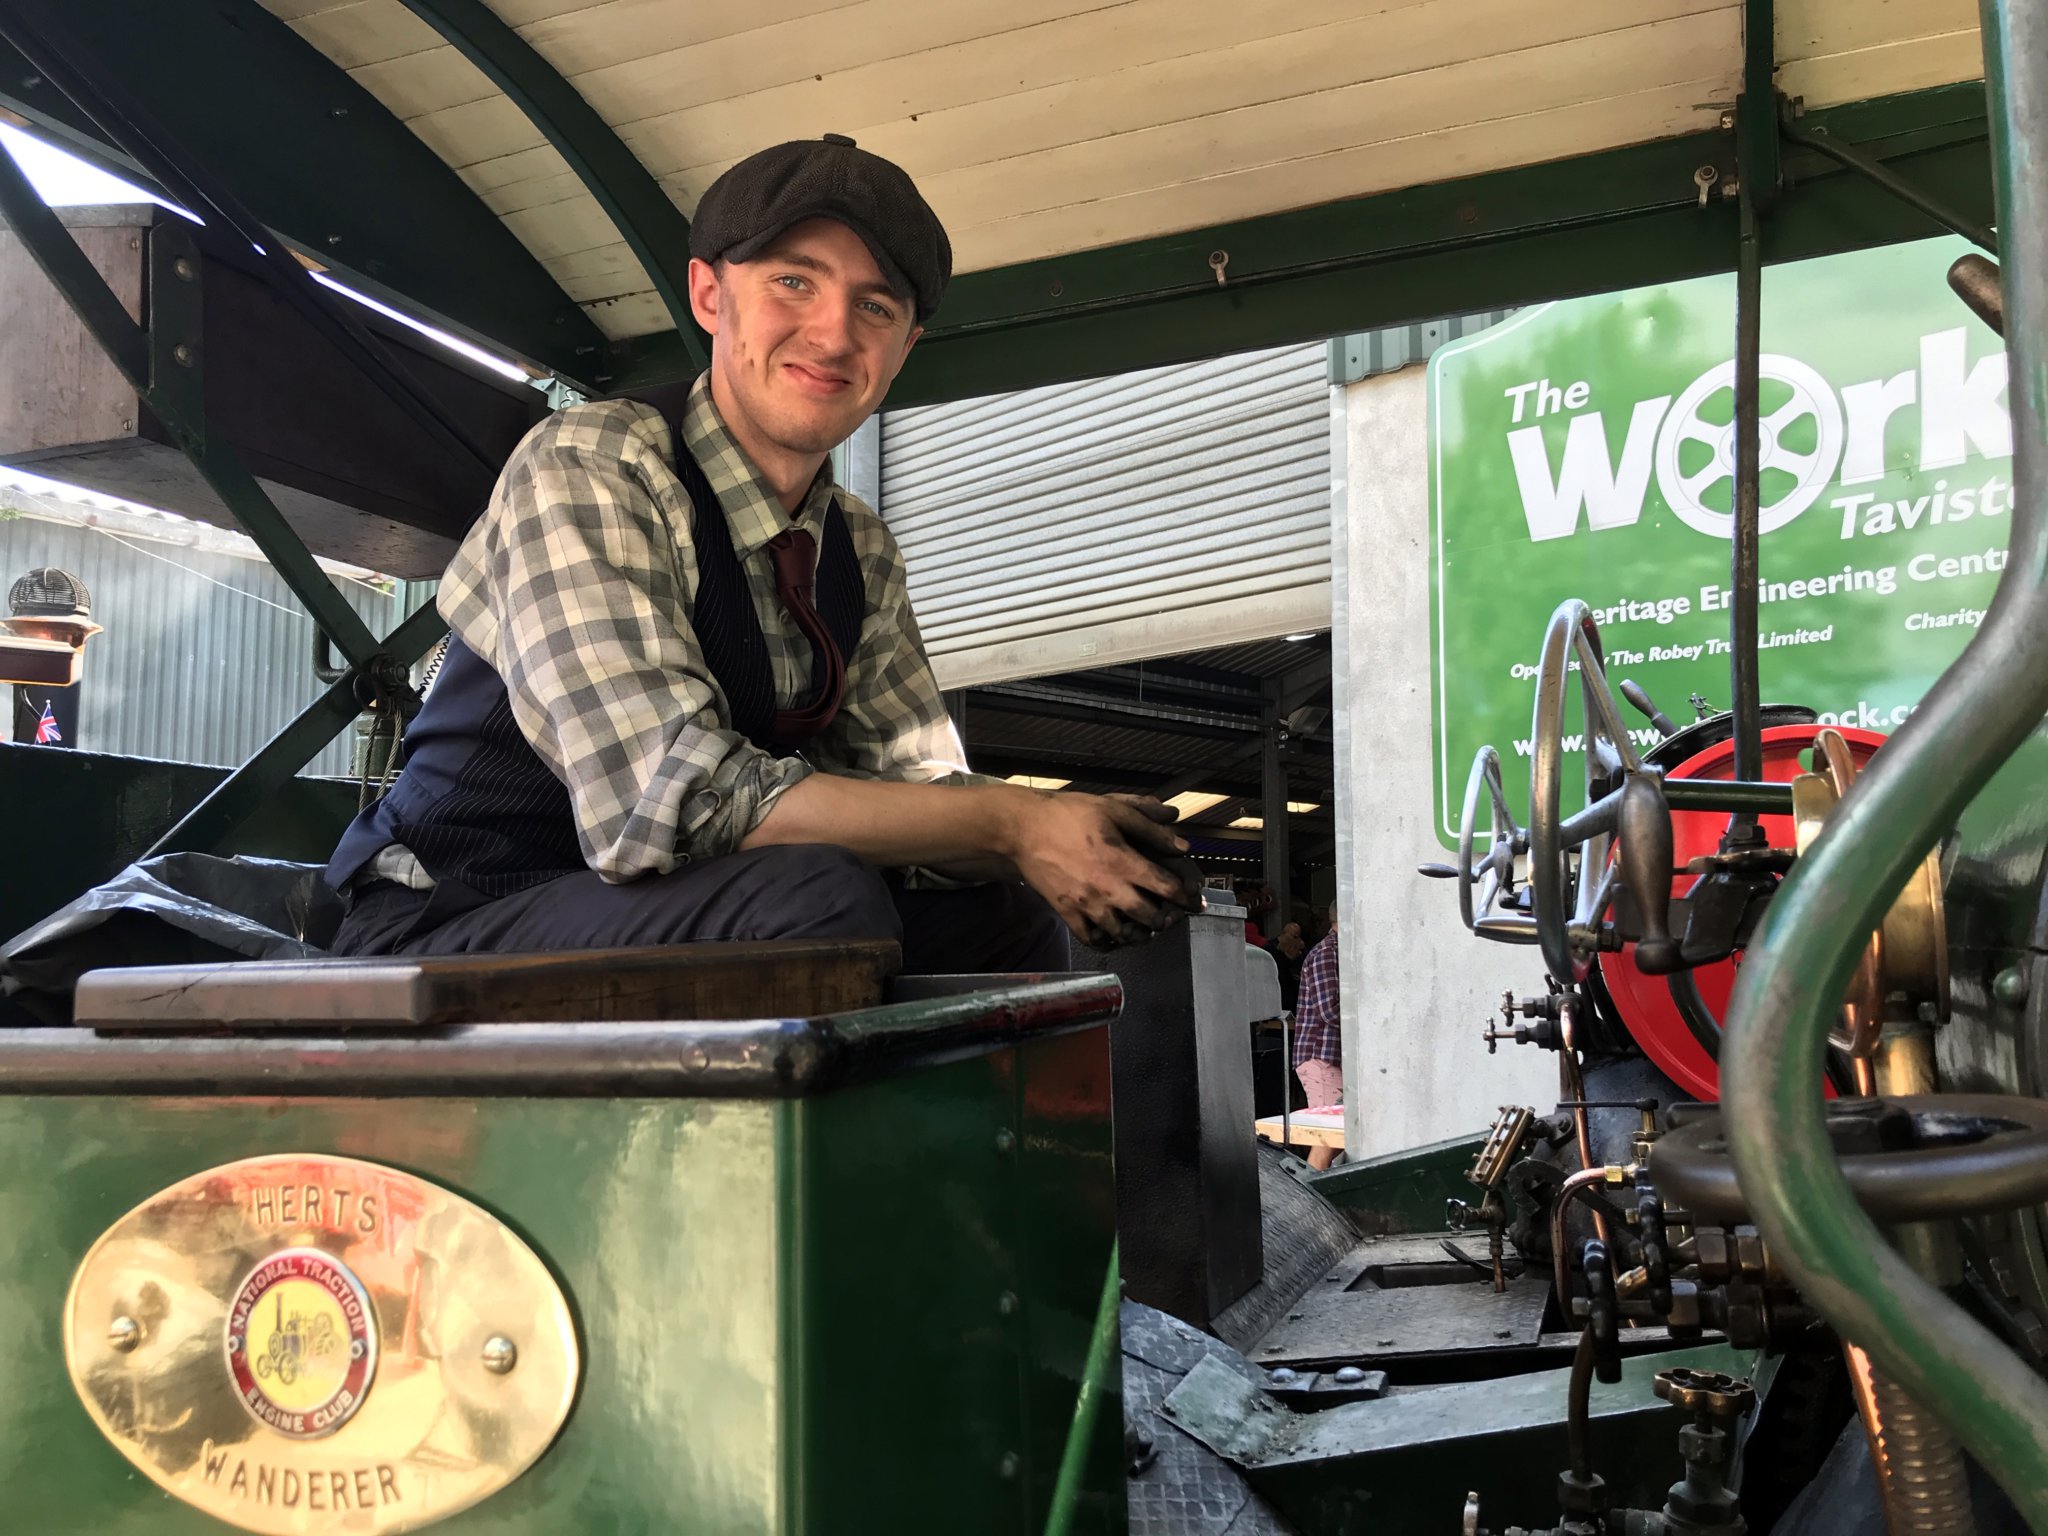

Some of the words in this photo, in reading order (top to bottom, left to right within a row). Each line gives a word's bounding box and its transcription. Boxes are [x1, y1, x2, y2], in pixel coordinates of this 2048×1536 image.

[1504, 377, 1591, 424] The
[1591, 596, 1691, 626] eritage
[1699, 565, 1897, 612] Enineering
[1904, 608, 1988, 631] Charity
[1611, 649, 1644, 667] The
[1648, 644, 1704, 661] Robey
[1705, 638, 1733, 656] Tru
[1757, 625, 1834, 649] Limited
[254, 1184, 377, 1233] HERTS
[231, 1258, 298, 1330] NATIONAL
[302, 1258, 366, 1332] TRACTION
[246, 1386, 305, 1433] ENGINE
[312, 1389, 354, 1429] CLUB
[203, 1440, 403, 1511] WANDERER
